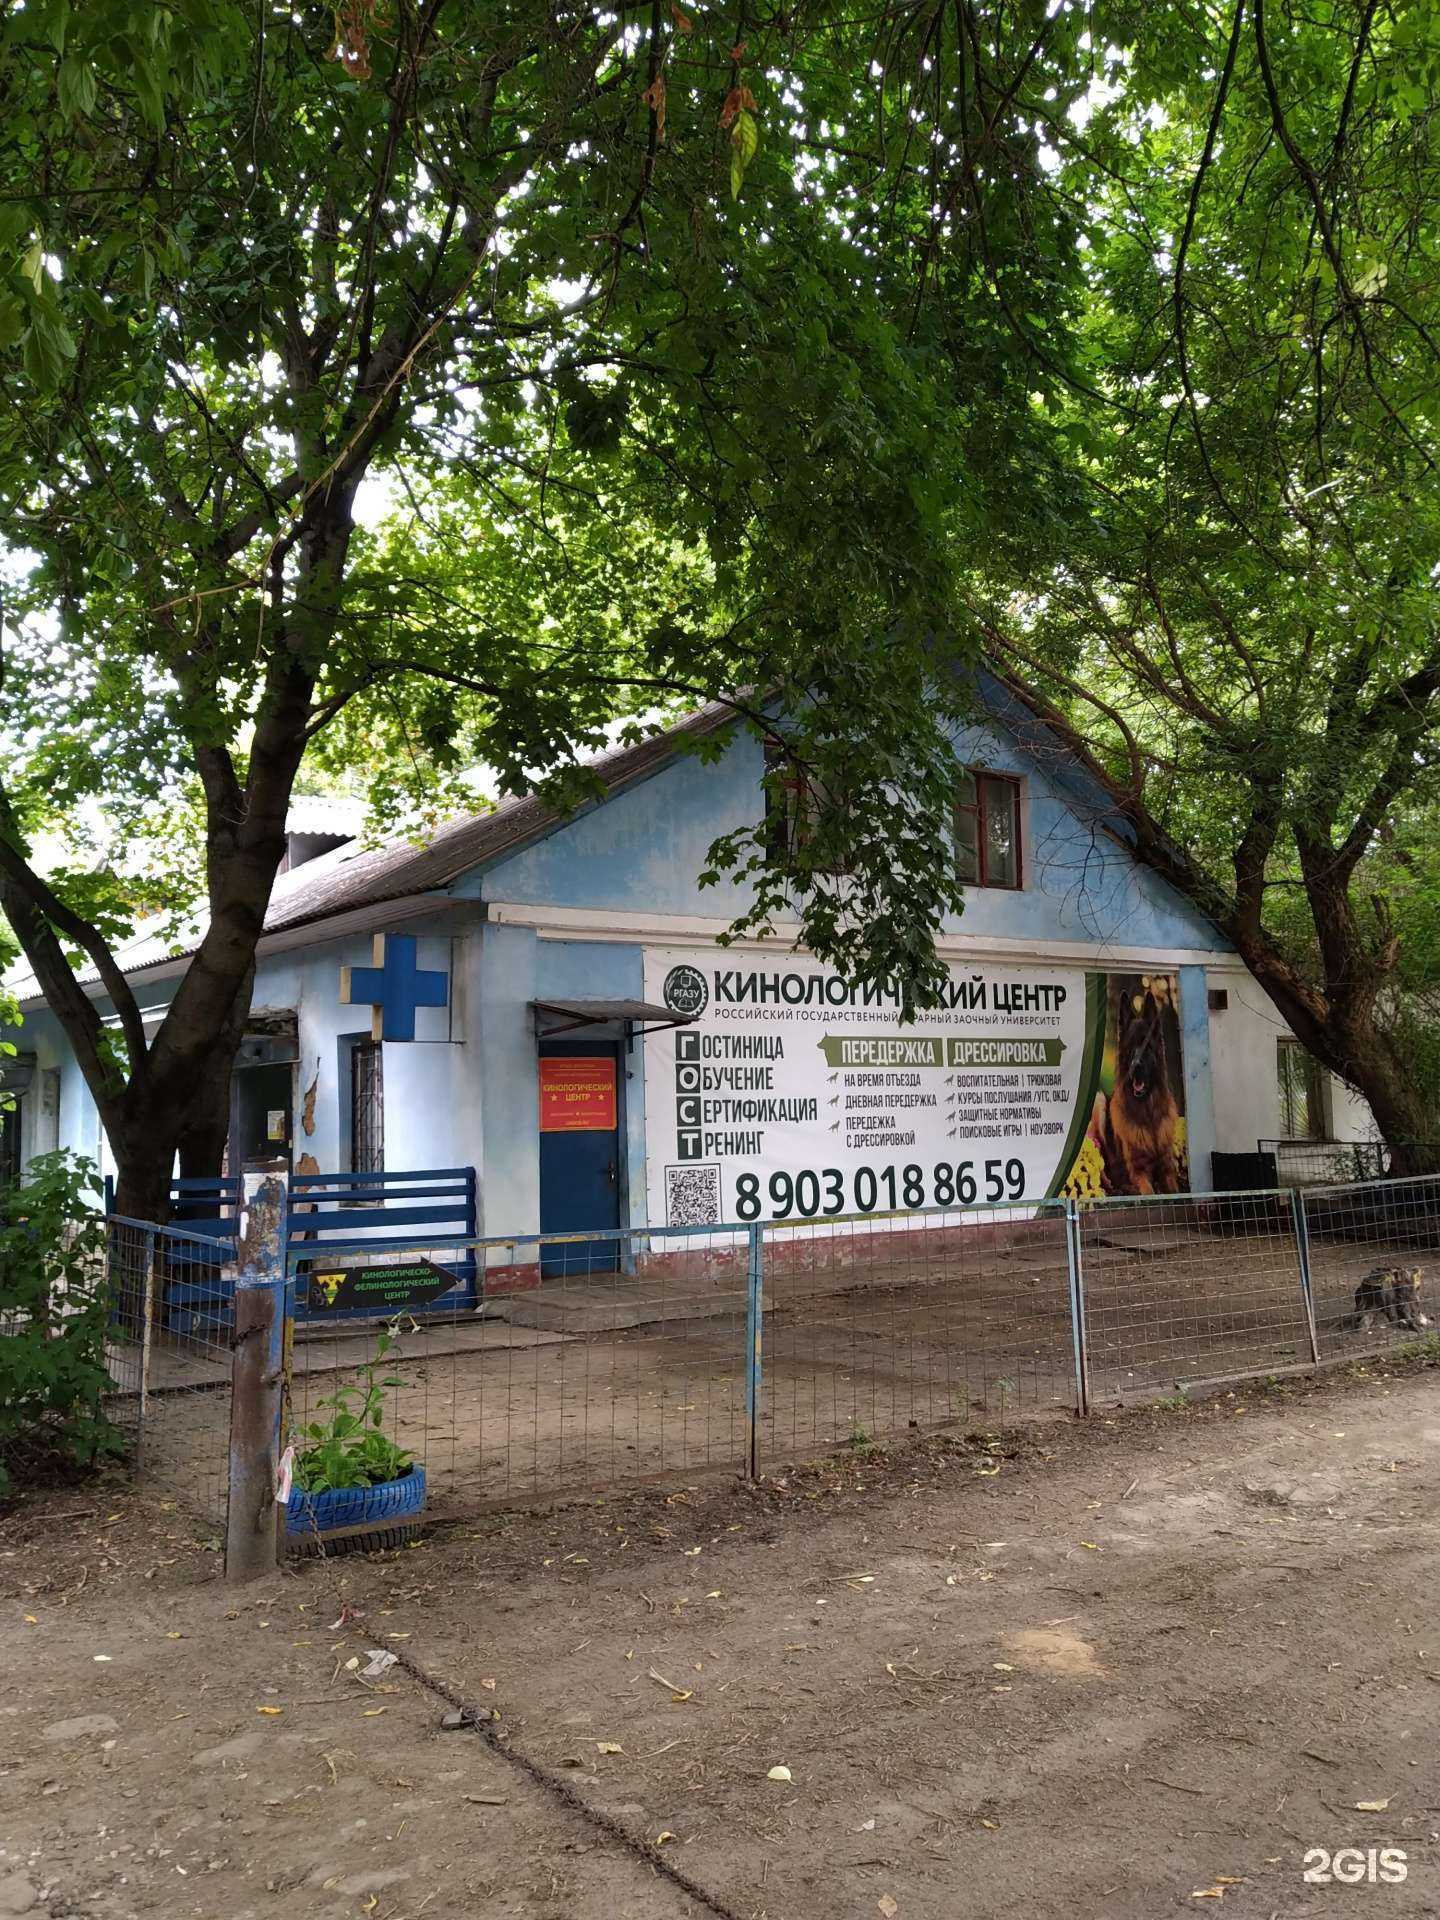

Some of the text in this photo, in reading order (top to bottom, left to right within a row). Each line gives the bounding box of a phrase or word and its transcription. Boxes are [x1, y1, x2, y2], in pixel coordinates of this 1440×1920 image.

[673, 988, 700, 998] РГАЗУ
[714, 970, 1067, 1014] КИНОЛОГИЧКИЙ ЦЕНТР
[714, 1008, 1061, 1026] РОССИЙСКИЙ ГОСУДАРСТВЕННЫЙ РАРНЫЙ ЗАОЧНЫЙ УНИВЕРСИТЕТ
[680, 1034, 784, 1061] ГОСТИНИЦА
[841, 1040, 936, 1065] ПЕРЕДЕРЖКА
[953, 1042, 1047, 1065] ДРЕССИРОВКА
[679, 1066, 774, 1091] ОБУЧЕНИЕ
[844, 1073, 922, 1087] НА ВРЕМЯ ОТЪЕЗДА
[957, 1074, 1062, 1087] ВОСПИТАТЕЛЬНАЯ ТРЮКОВАЯ
[845, 1094, 937, 1109] ДНЕВНАЯ ПЕРЕДЕРЖКА
[957, 1091, 983, 1104] КУРСЫ
[984, 1091, 1032, 1104] ПОСЛУШАНИЯ
[679, 1097, 818, 1124] СЕРТИФИКАЦИЯ
[959, 1106, 1042, 1122] ЗАЩИТНЫЕ НОРМАТИВЫ
[846, 1115, 896, 1131] ПЕРЕДЕЖКА
[960, 1121, 1065, 1138] ПОИСКОВЫЕ ИГРЫ НОУЗВОРК
[681, 1130, 765, 1156] ТРЕНИНГ
[846, 1130, 916, 1149] С ДРЕССИРОВКОЙ
[735, 1157, 1026, 1222] 8 903 018 86 59
[384, 1290, 410, 1300] ЦЕНТР
